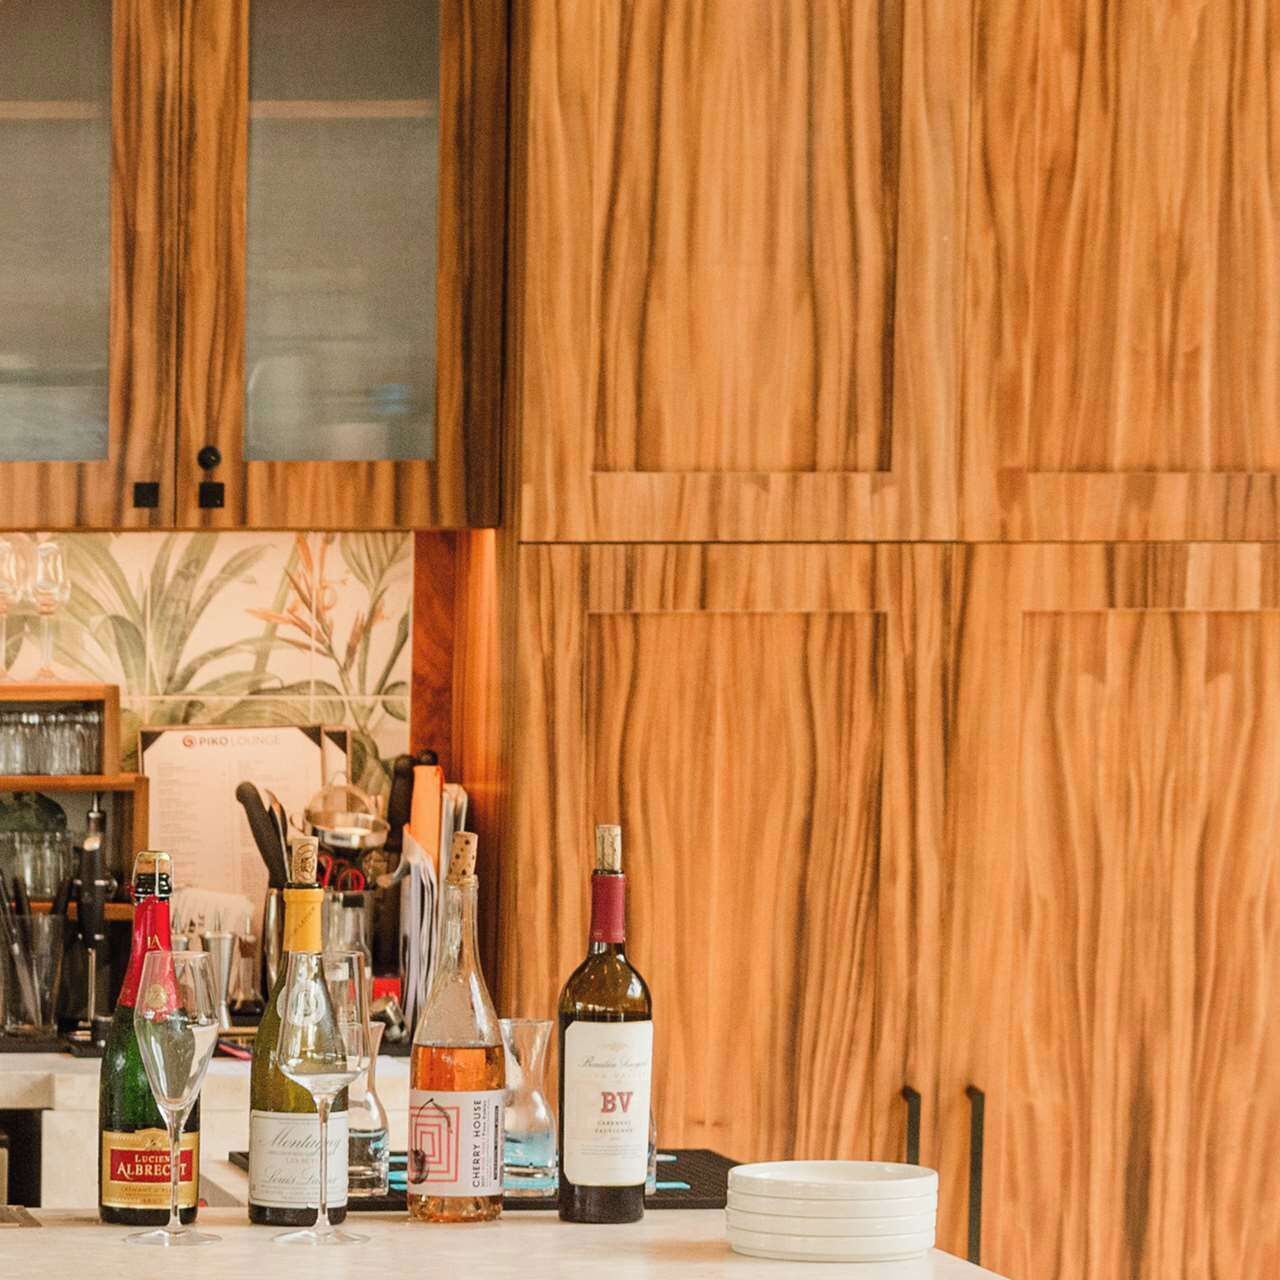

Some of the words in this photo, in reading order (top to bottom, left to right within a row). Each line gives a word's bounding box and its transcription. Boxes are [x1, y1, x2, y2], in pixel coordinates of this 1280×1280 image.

[199, 736, 229, 746] PIKO
[231, 734, 281, 746] LOUNGE
[600, 1091, 634, 1113] BV
[473, 1100, 482, 1138] HOUSE
[135, 1154, 171, 1163] LUCIEN
[472, 1144, 481, 1188] CHERRY
[117, 1160, 187, 1180] ALBRECT
